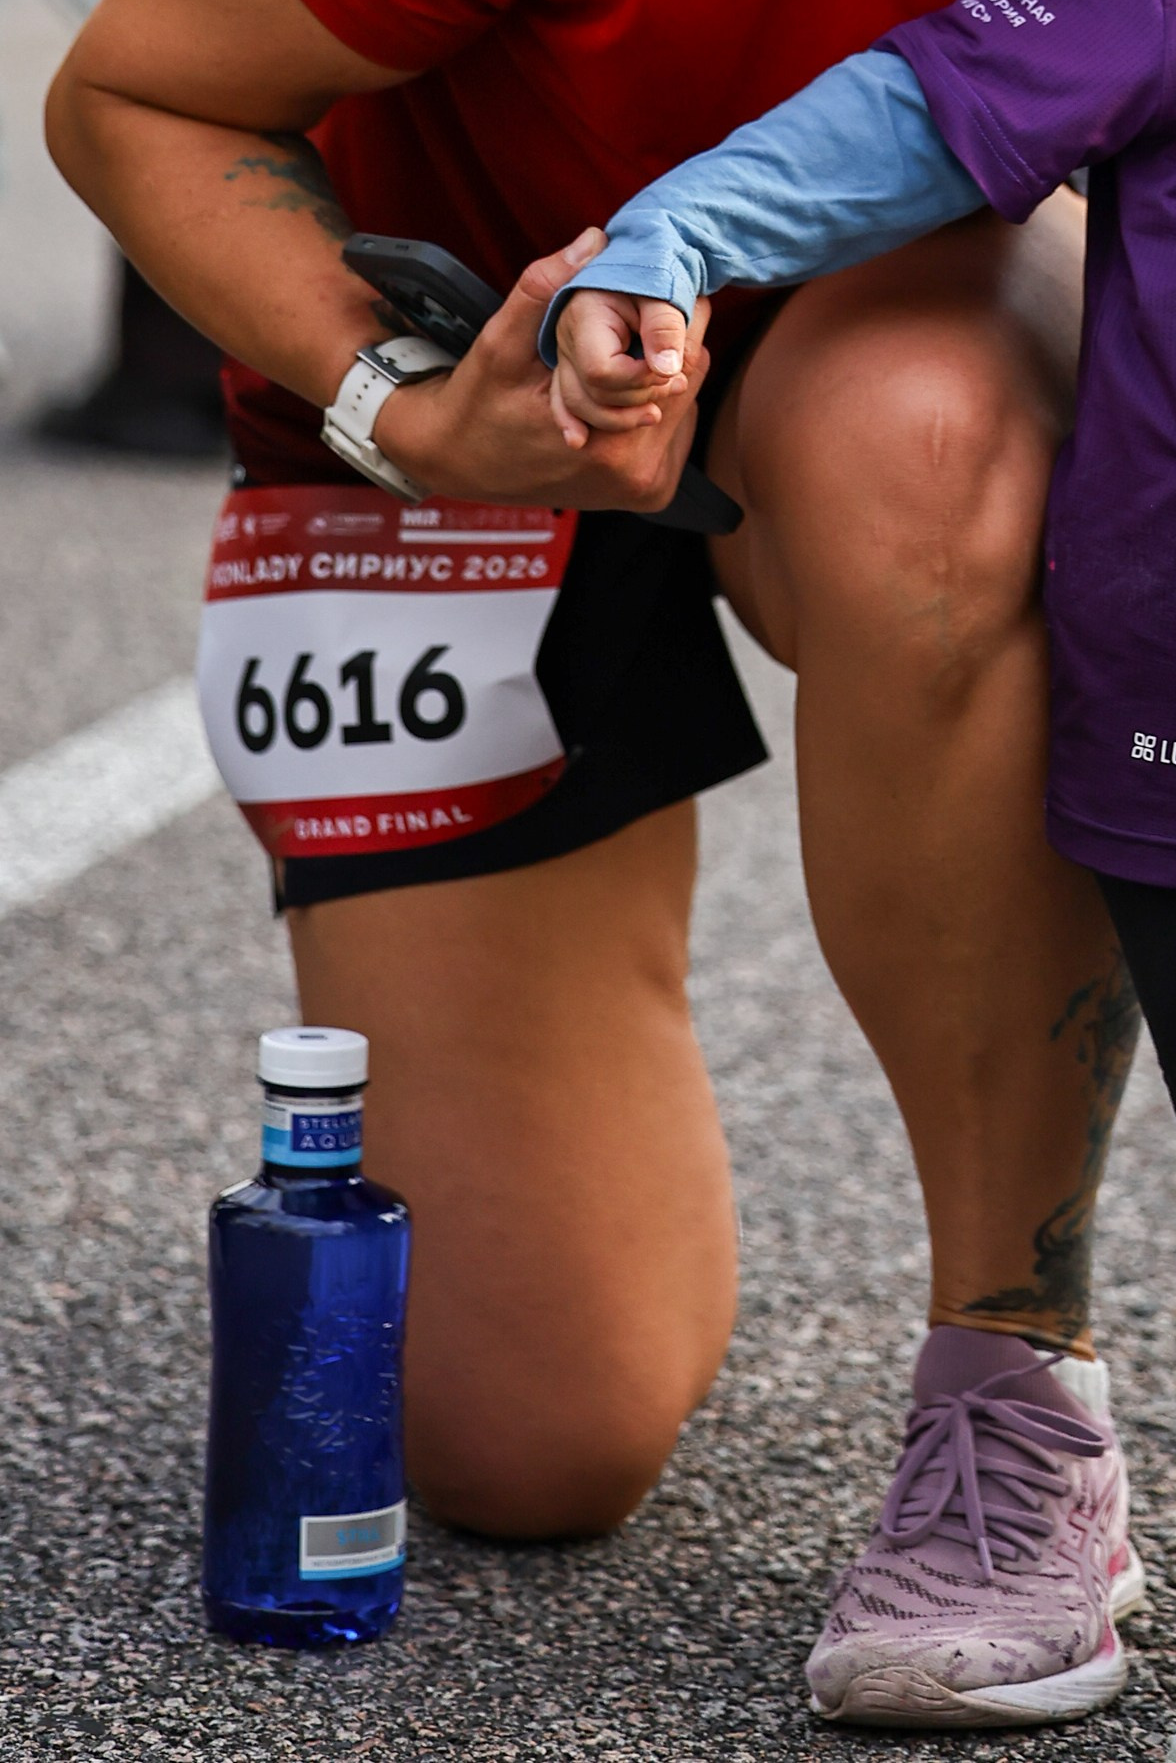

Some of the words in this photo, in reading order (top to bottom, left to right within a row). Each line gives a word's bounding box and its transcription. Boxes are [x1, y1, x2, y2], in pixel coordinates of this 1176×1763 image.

[309, 552, 454, 582] СИРИУС
[235, 643, 467, 755] 6616
[376, 804, 474, 835] FINAL
